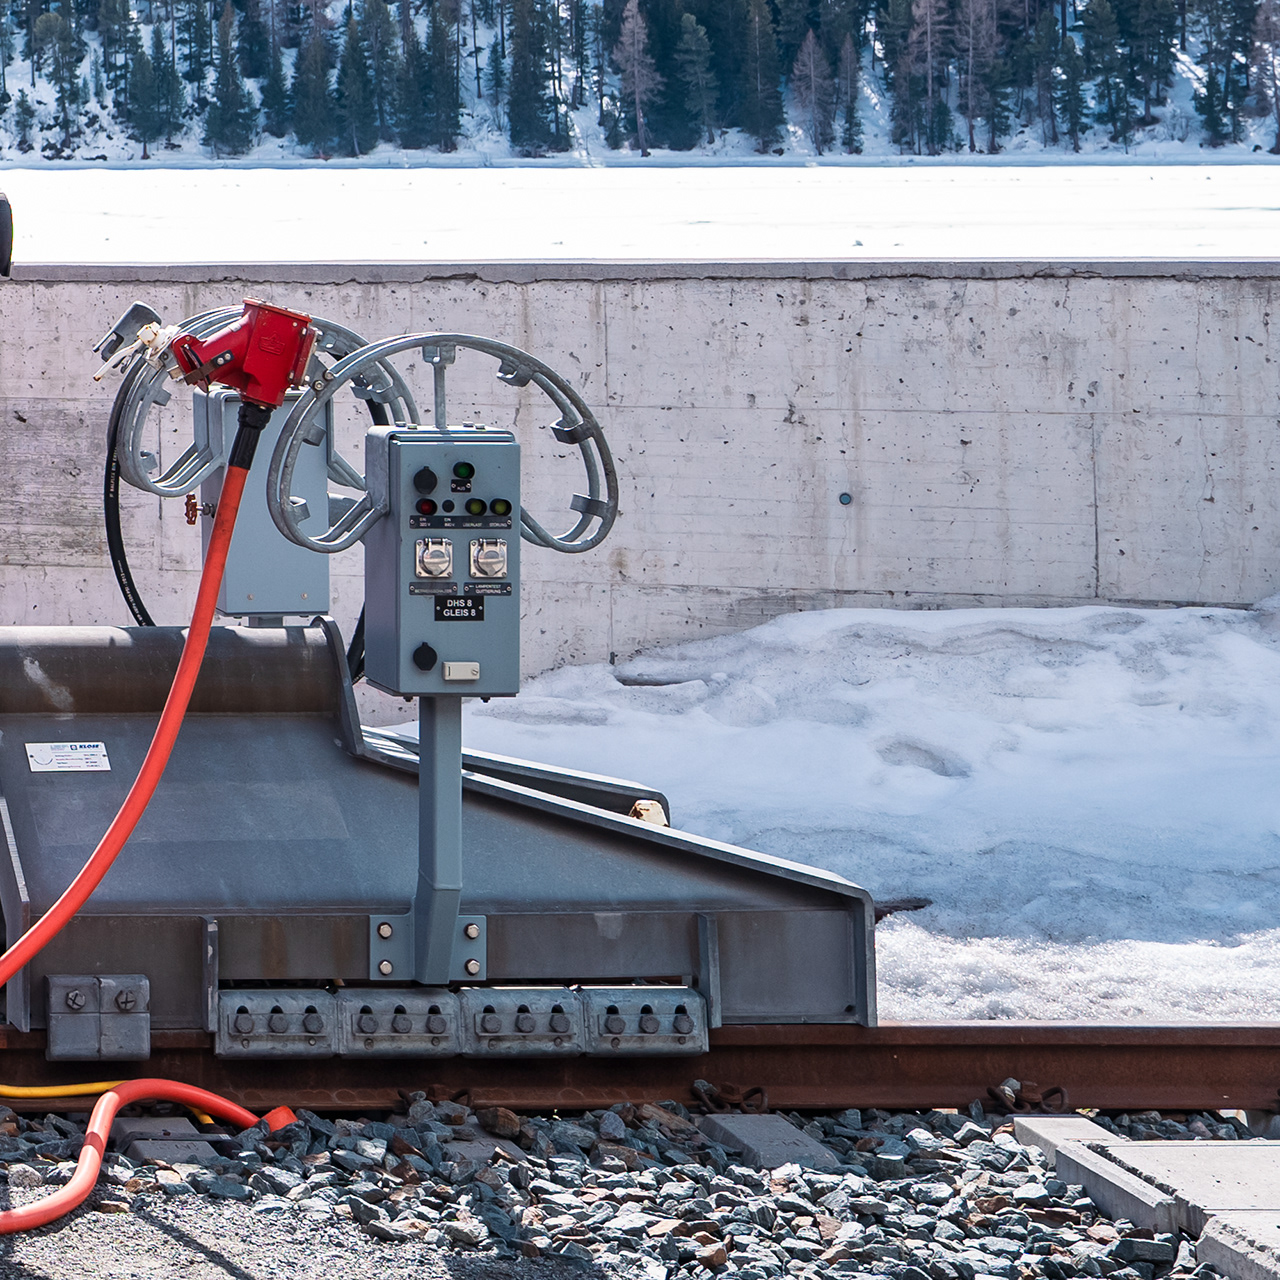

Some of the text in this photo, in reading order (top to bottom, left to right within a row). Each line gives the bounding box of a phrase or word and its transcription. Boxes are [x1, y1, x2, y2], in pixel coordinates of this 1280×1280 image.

[447, 599, 473, 607] DHS 8
[443, 608, 476, 617] GLEIS 8
